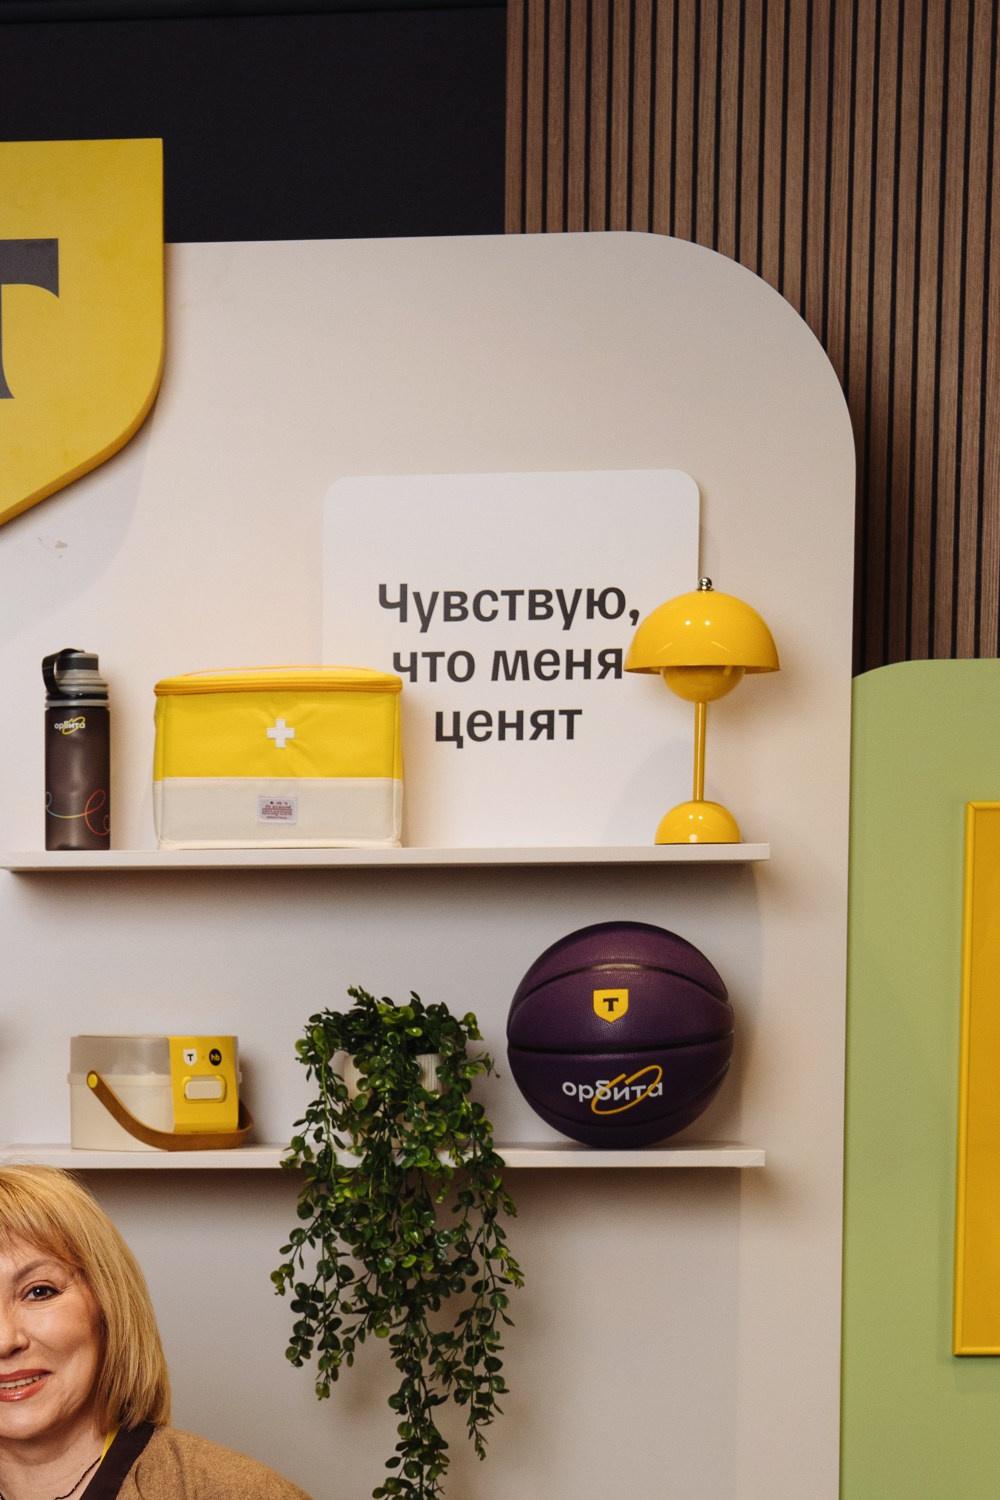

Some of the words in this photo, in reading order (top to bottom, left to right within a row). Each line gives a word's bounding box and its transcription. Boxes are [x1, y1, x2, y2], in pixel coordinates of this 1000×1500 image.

[378, 583, 641, 634] Чувствую,
[393, 650, 476, 683] что
[490, 648, 624, 682] меня
[434, 708, 583, 749] ценят
[561, 1077, 664, 1105] орбита
